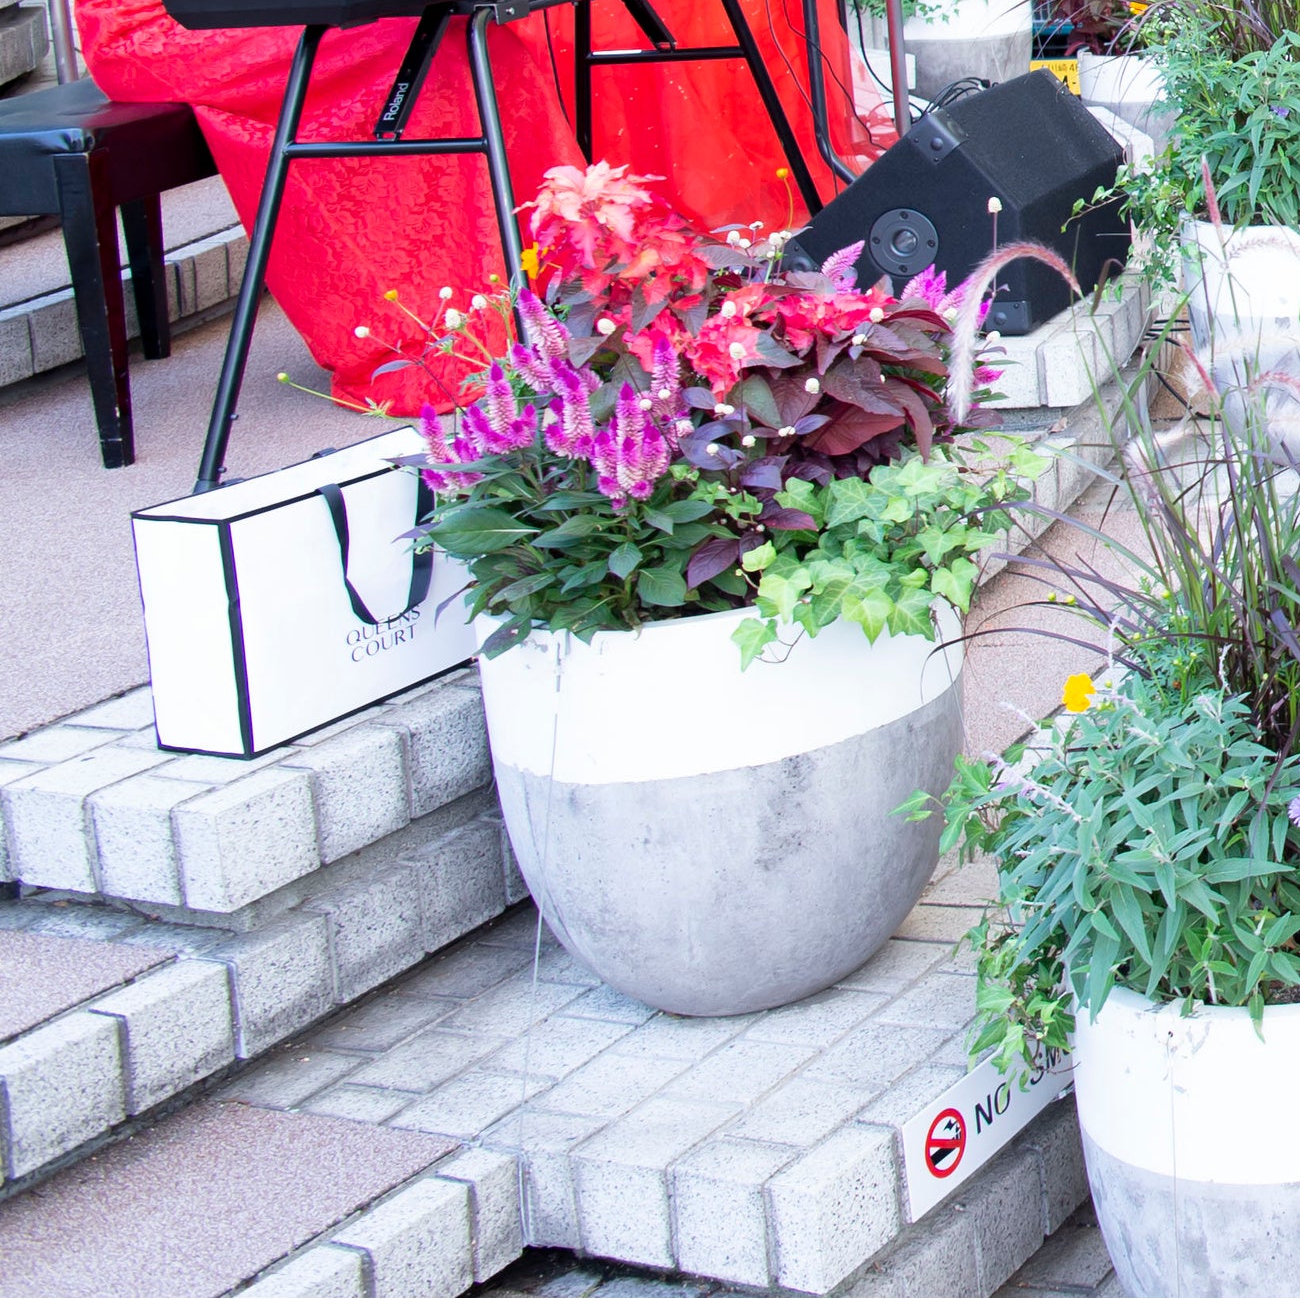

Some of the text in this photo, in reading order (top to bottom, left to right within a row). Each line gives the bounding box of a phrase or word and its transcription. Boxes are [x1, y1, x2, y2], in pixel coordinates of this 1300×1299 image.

[383, 83, 409, 121] Roland
[346, 605, 421, 645] QUEENS
[351, 623, 416, 663] COURT
[974, 1081, 1011, 1134] NO
